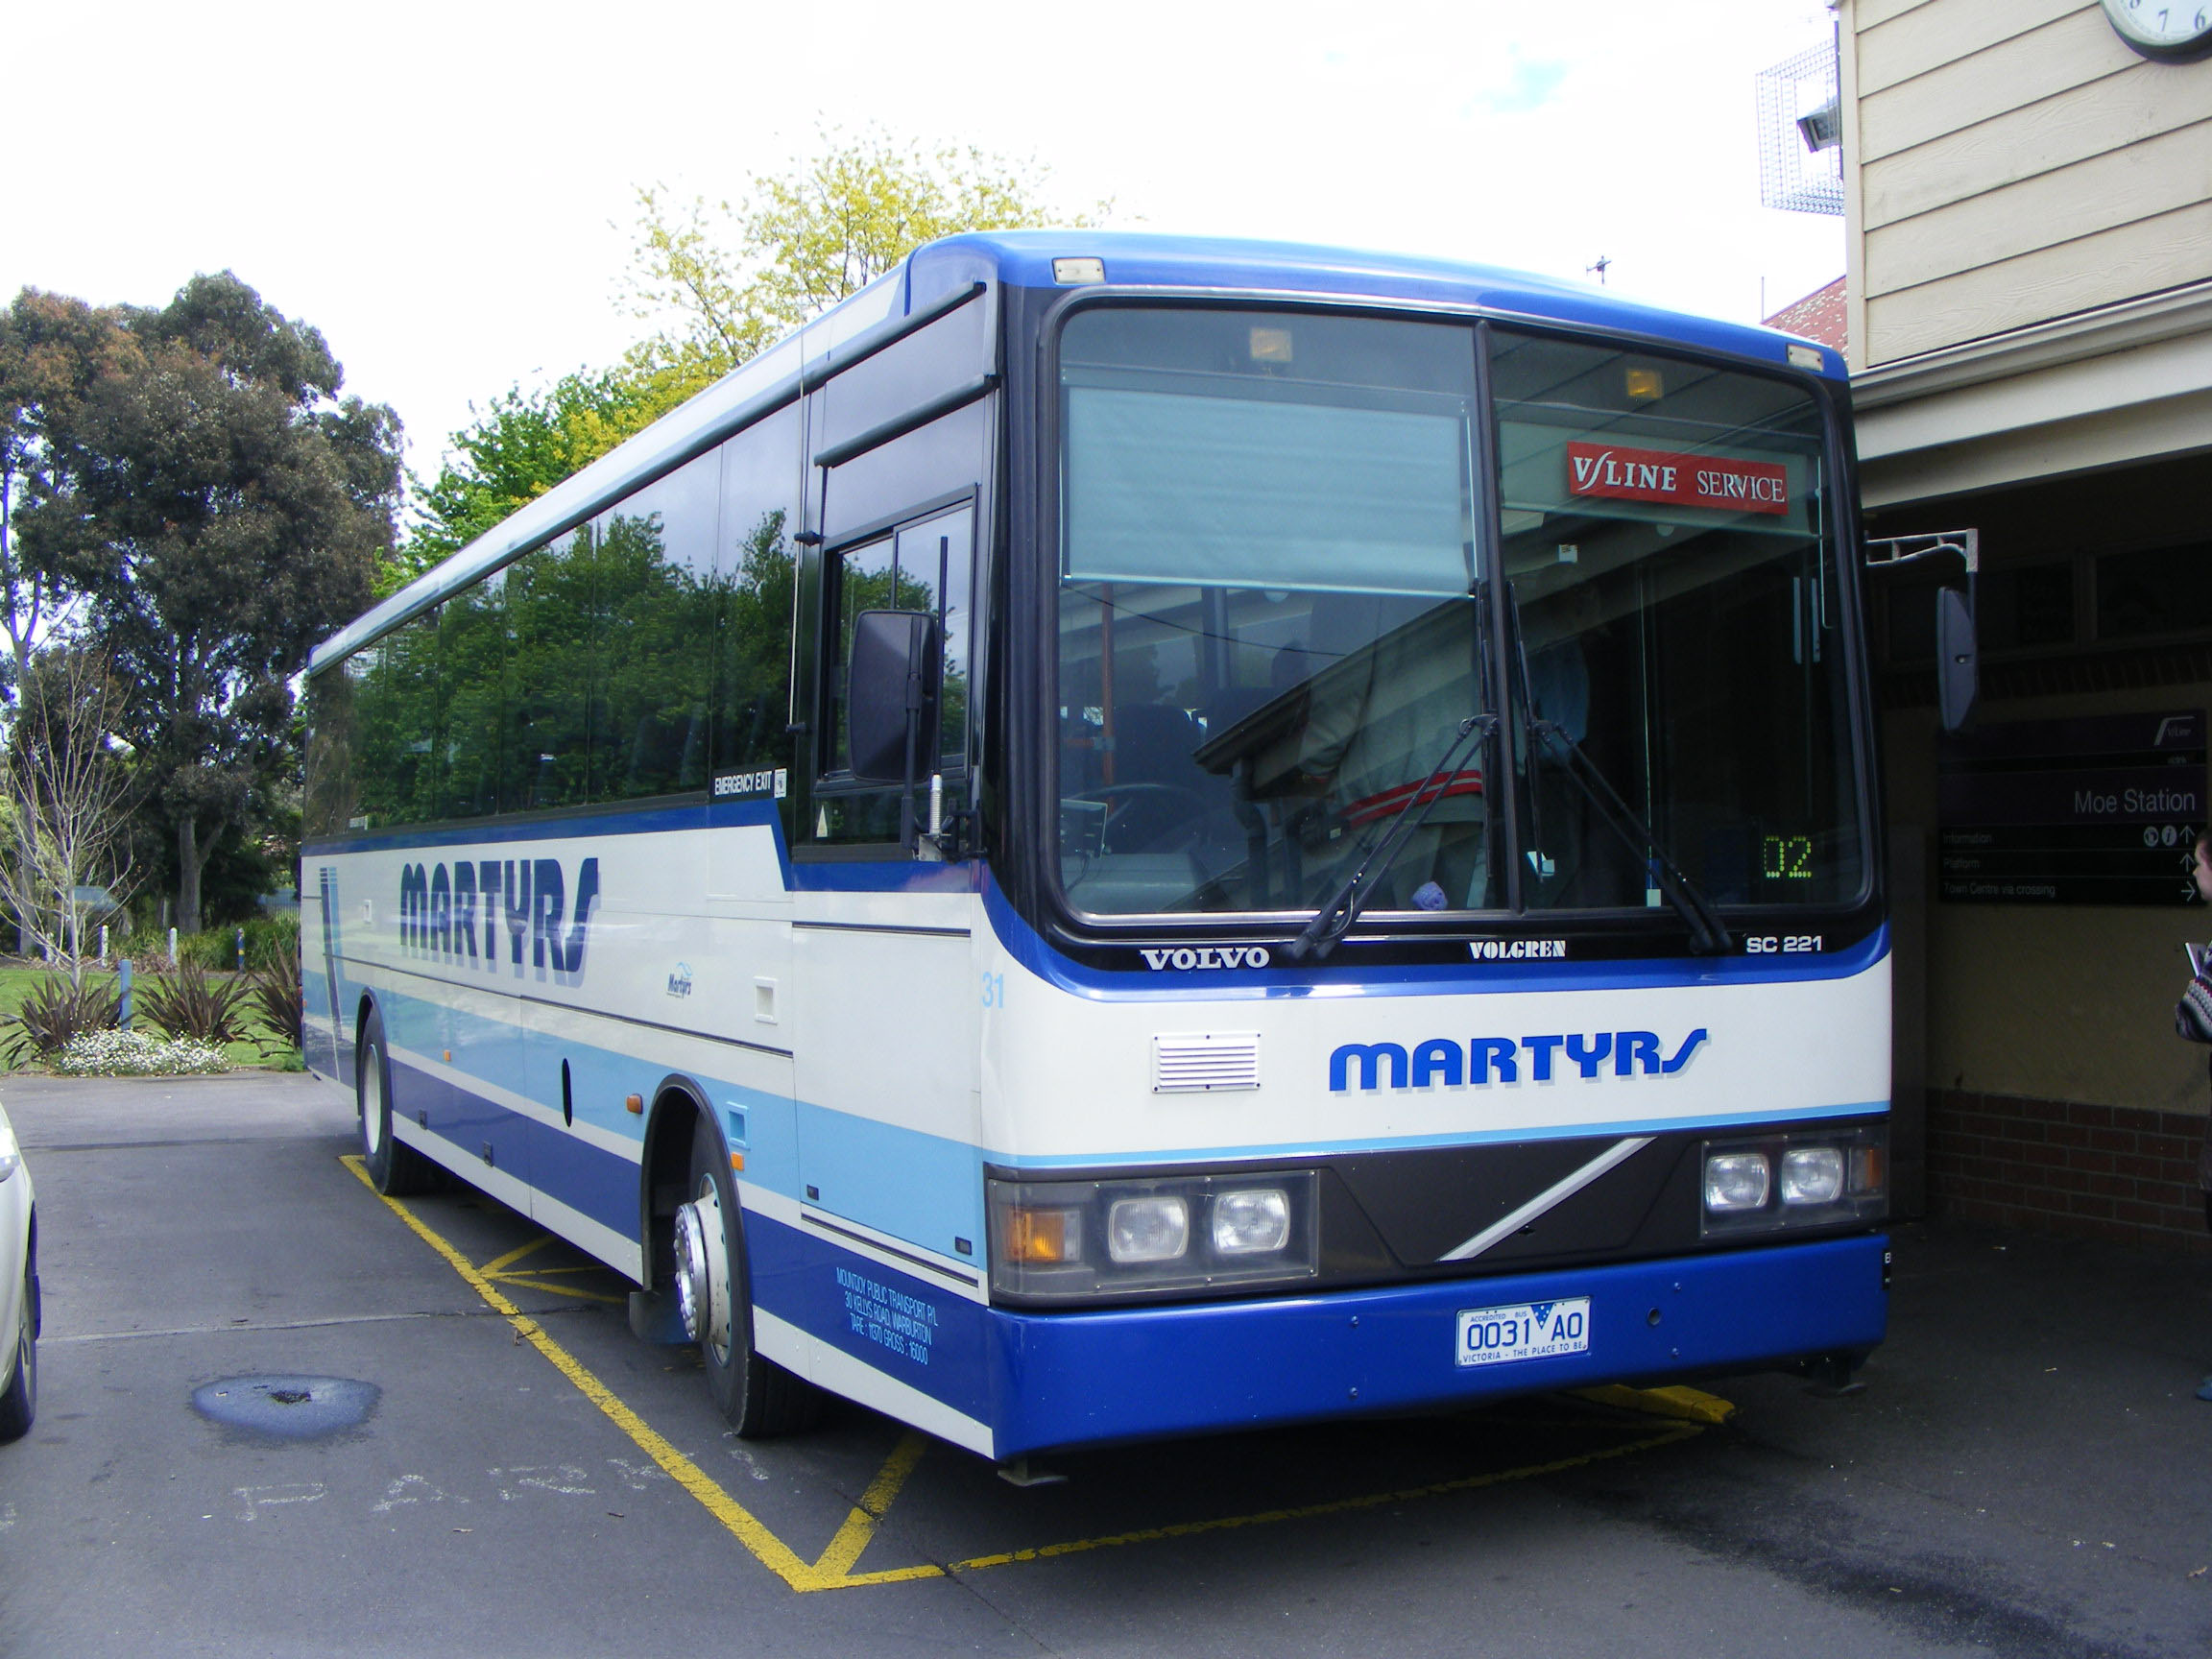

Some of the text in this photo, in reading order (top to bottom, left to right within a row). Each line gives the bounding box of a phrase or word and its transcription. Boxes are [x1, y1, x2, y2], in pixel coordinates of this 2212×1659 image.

[2158, 8, 2169, 32] 7
[2195, 6, 2206, 31] 6
[1696, 469, 1786, 504] SERVICE
[715, 773, 755, 796] EMERGENCY
[756, 770, 772, 791] EXIT
[2075, 787, 2197, 814] Moe Station
[1764, 836, 1812, 878] 02
[2016, 882, 2056, 898] crossing
[400, 857, 599, 973] MARTYRS
[1469, 940, 1567, 960] VOLGREN
[1746, 935, 1822, 953] SC 221
[1140, 947, 1270, 971] VOLVO
[982, 971, 1004, 1008] 31
[1329, 1029, 1707, 1092] MARTYRS
[867, 1280, 888, 1305] PUBLIC
[888, 1288, 926, 1321] TRANSPORT
[892, 1310, 932, 1346] WARBURTON
[1470, 1310, 1527, 1323] ACCREDITED BUS
[883, 1329, 905, 1355] GROSS
[1467, 1318, 1530, 1351] 0031
[1463, 1352, 1501, 1363] VICTORIA
[1513, 1348, 1527, 1357] THE
[1531, 1345, 1555, 1355] PLACE
[1559, 1343, 1569, 1352] TO
[1574, 1341, 1582, 1350] BE
